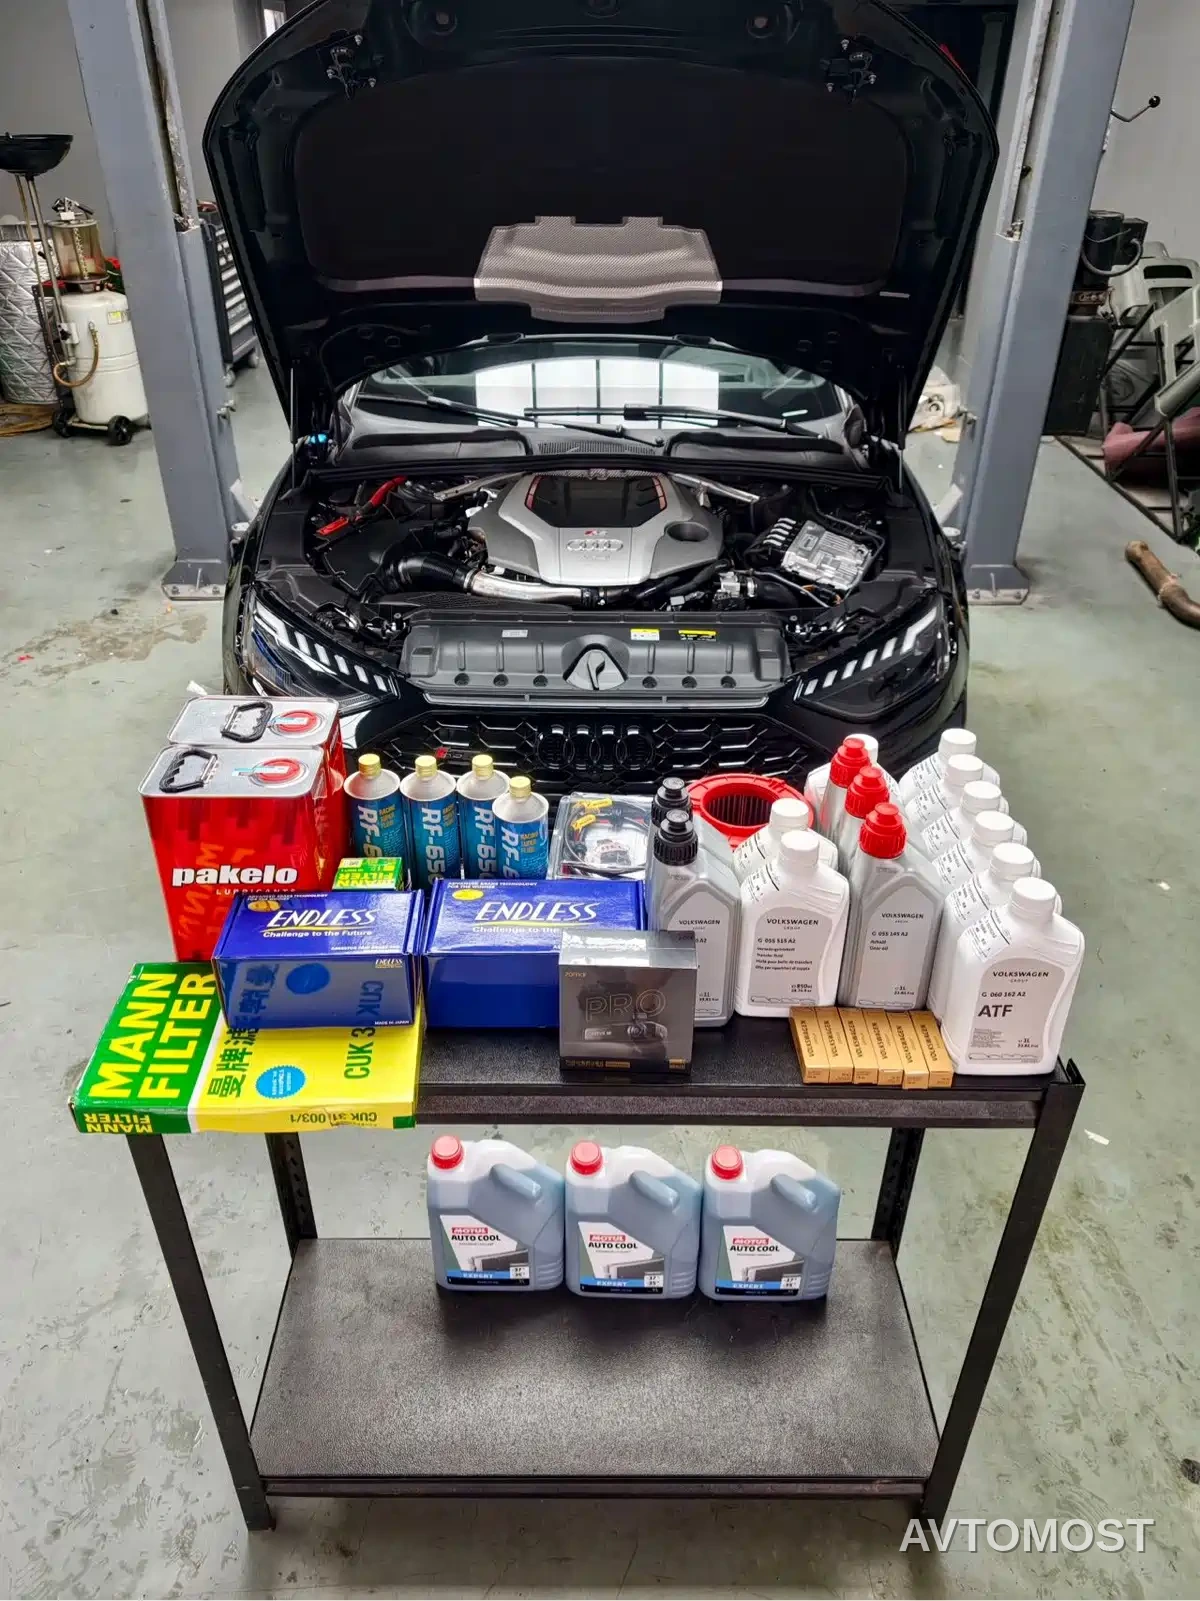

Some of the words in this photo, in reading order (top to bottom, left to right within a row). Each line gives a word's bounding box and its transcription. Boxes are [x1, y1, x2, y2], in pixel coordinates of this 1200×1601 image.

[172, 865, 298, 886] pakelo
[266, 908, 380, 927] ENDLESS
[474, 901, 600, 921] ENDLESS
[472, 926, 526, 934] Challenge
[767, 918, 819, 926] VOLKSWAGEN
[585, 988, 667, 1022] PRO
[978, 1004, 1013, 1018] ATF
[88, 973, 178, 1098] MANN
[137, 973, 216, 1099] FILTER
[344, 1041, 374, 1080] CUK
[83, 1113, 151, 1124] FILTER
[290, 1112, 326, 1123] 003/1
[351, 1111, 377, 1122] CUK
[86, 1123, 153, 1133] MANN
